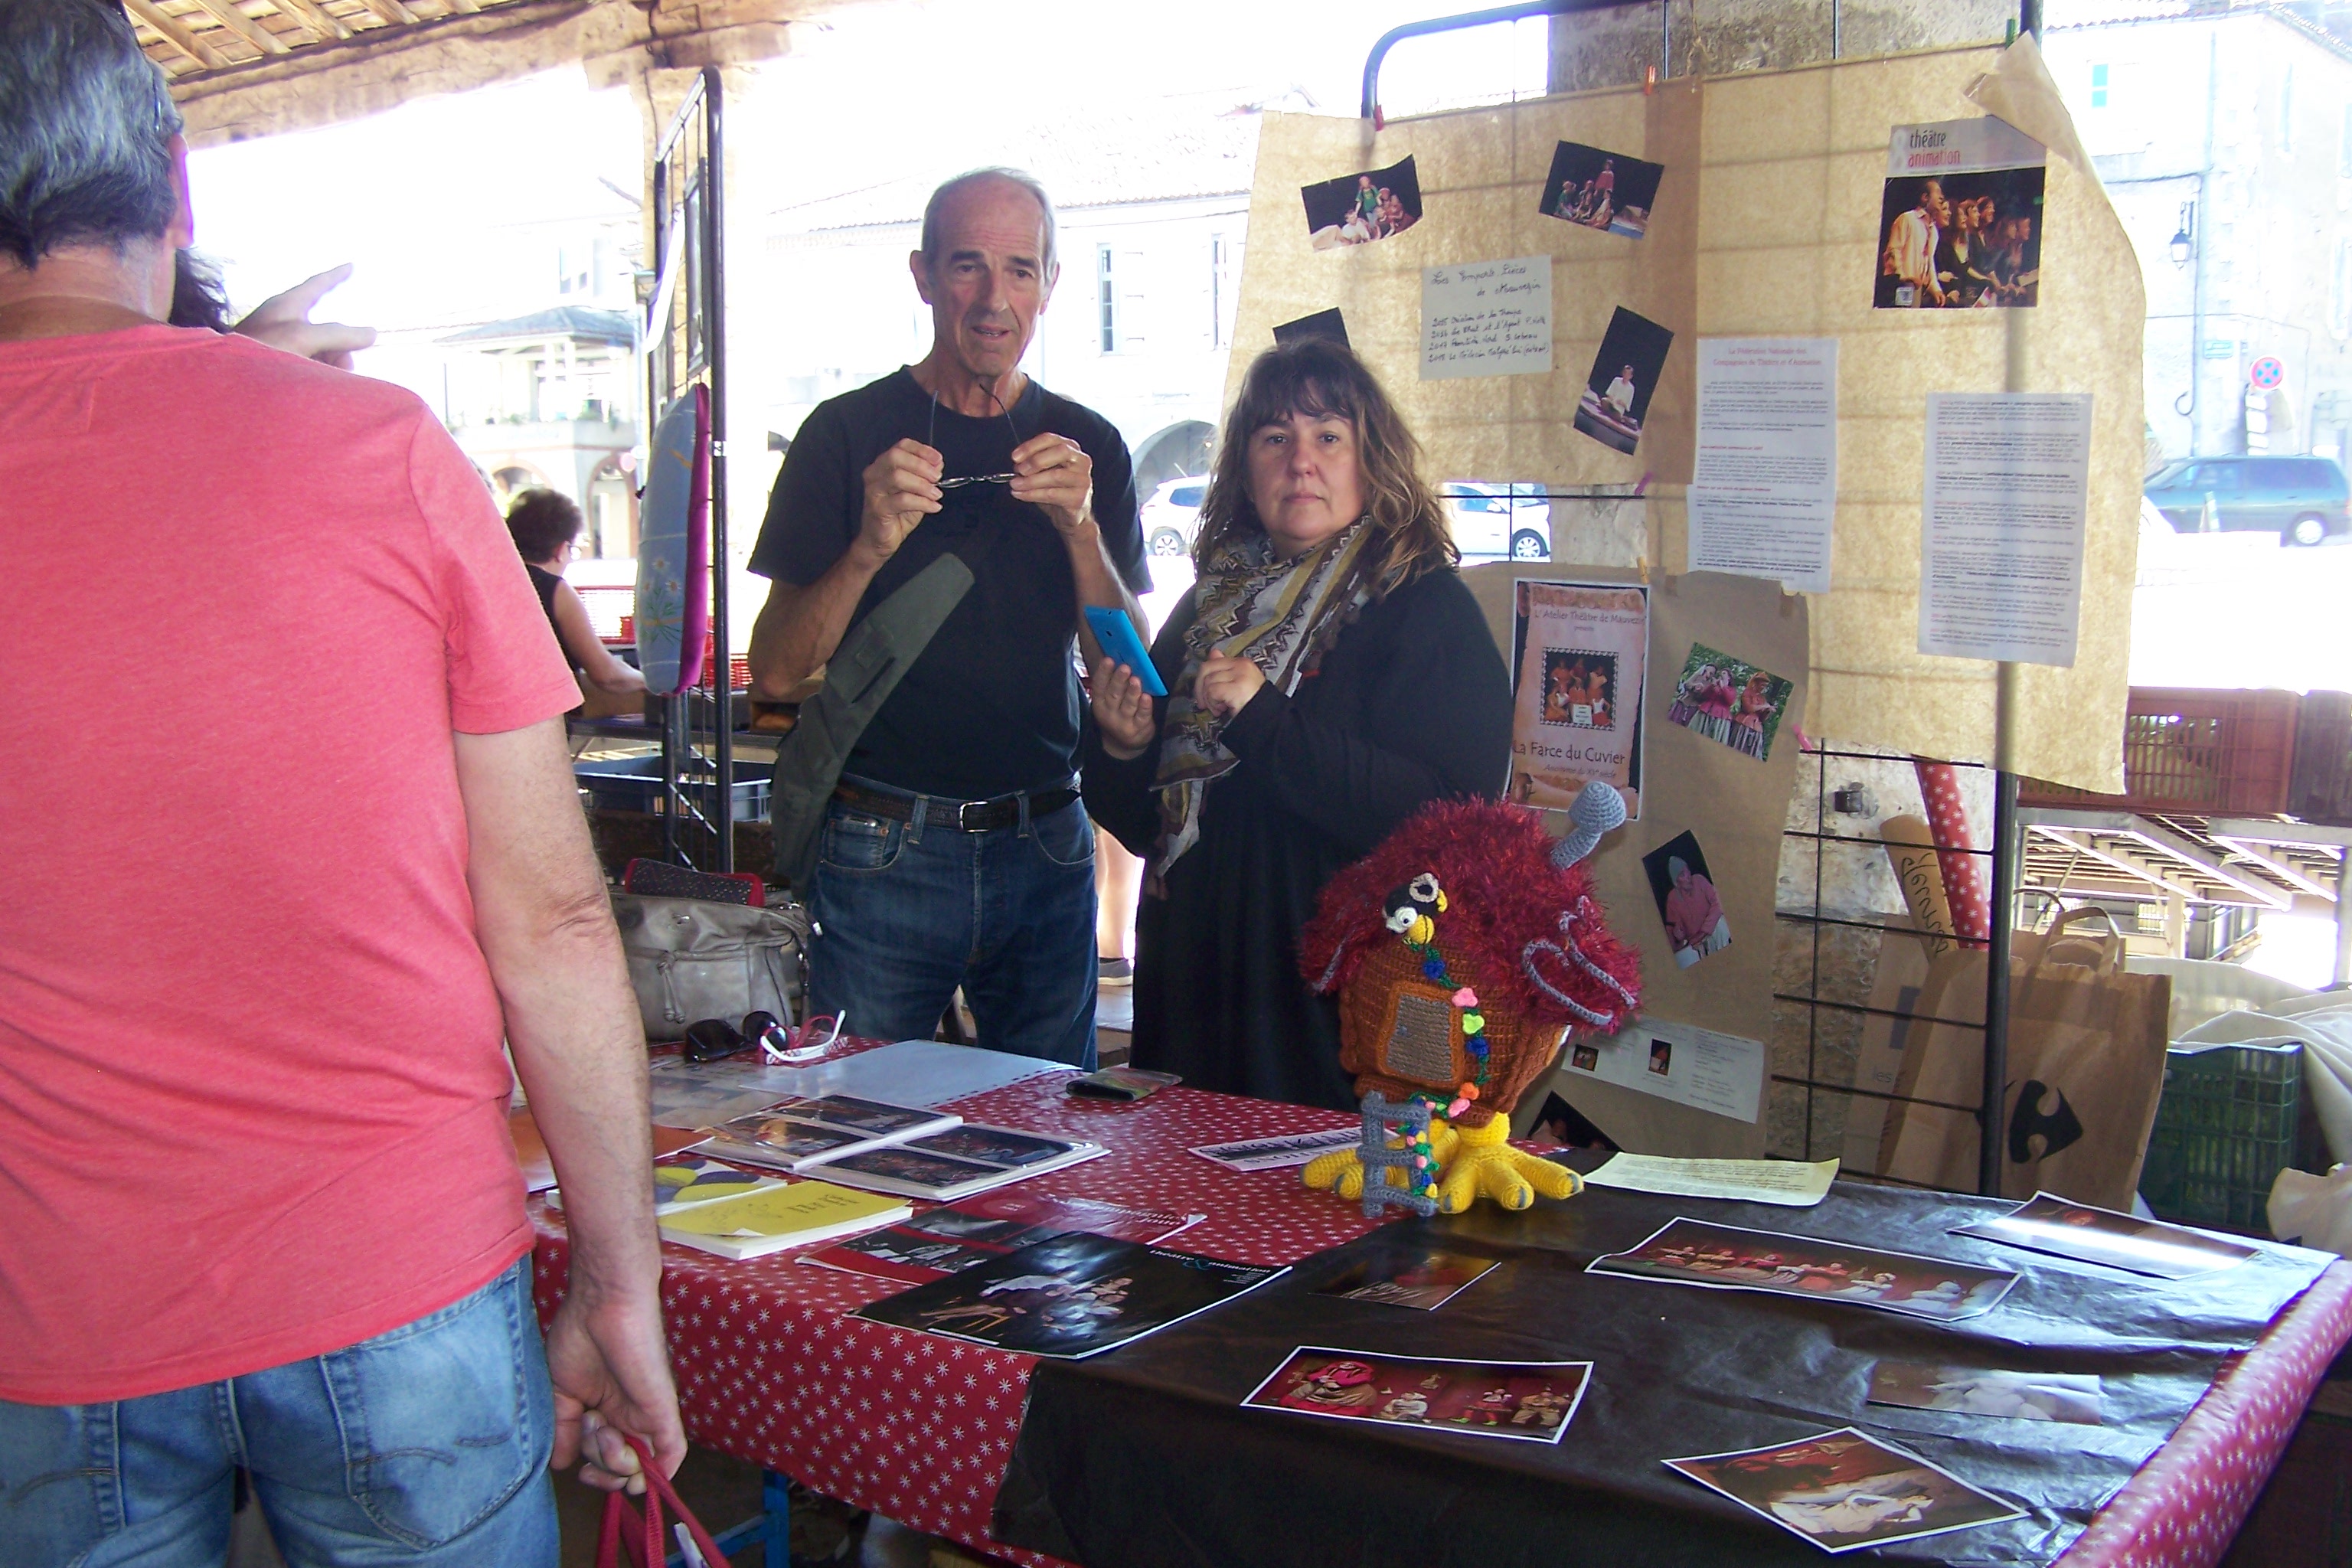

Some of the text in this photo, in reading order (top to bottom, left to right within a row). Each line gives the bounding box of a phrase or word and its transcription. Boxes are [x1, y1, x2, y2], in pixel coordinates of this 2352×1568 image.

[1909, 129, 1946, 149] théâtre
[1908, 149, 1961, 168] animation
[1513, 740, 1626, 765] La Farce du Cuvier
